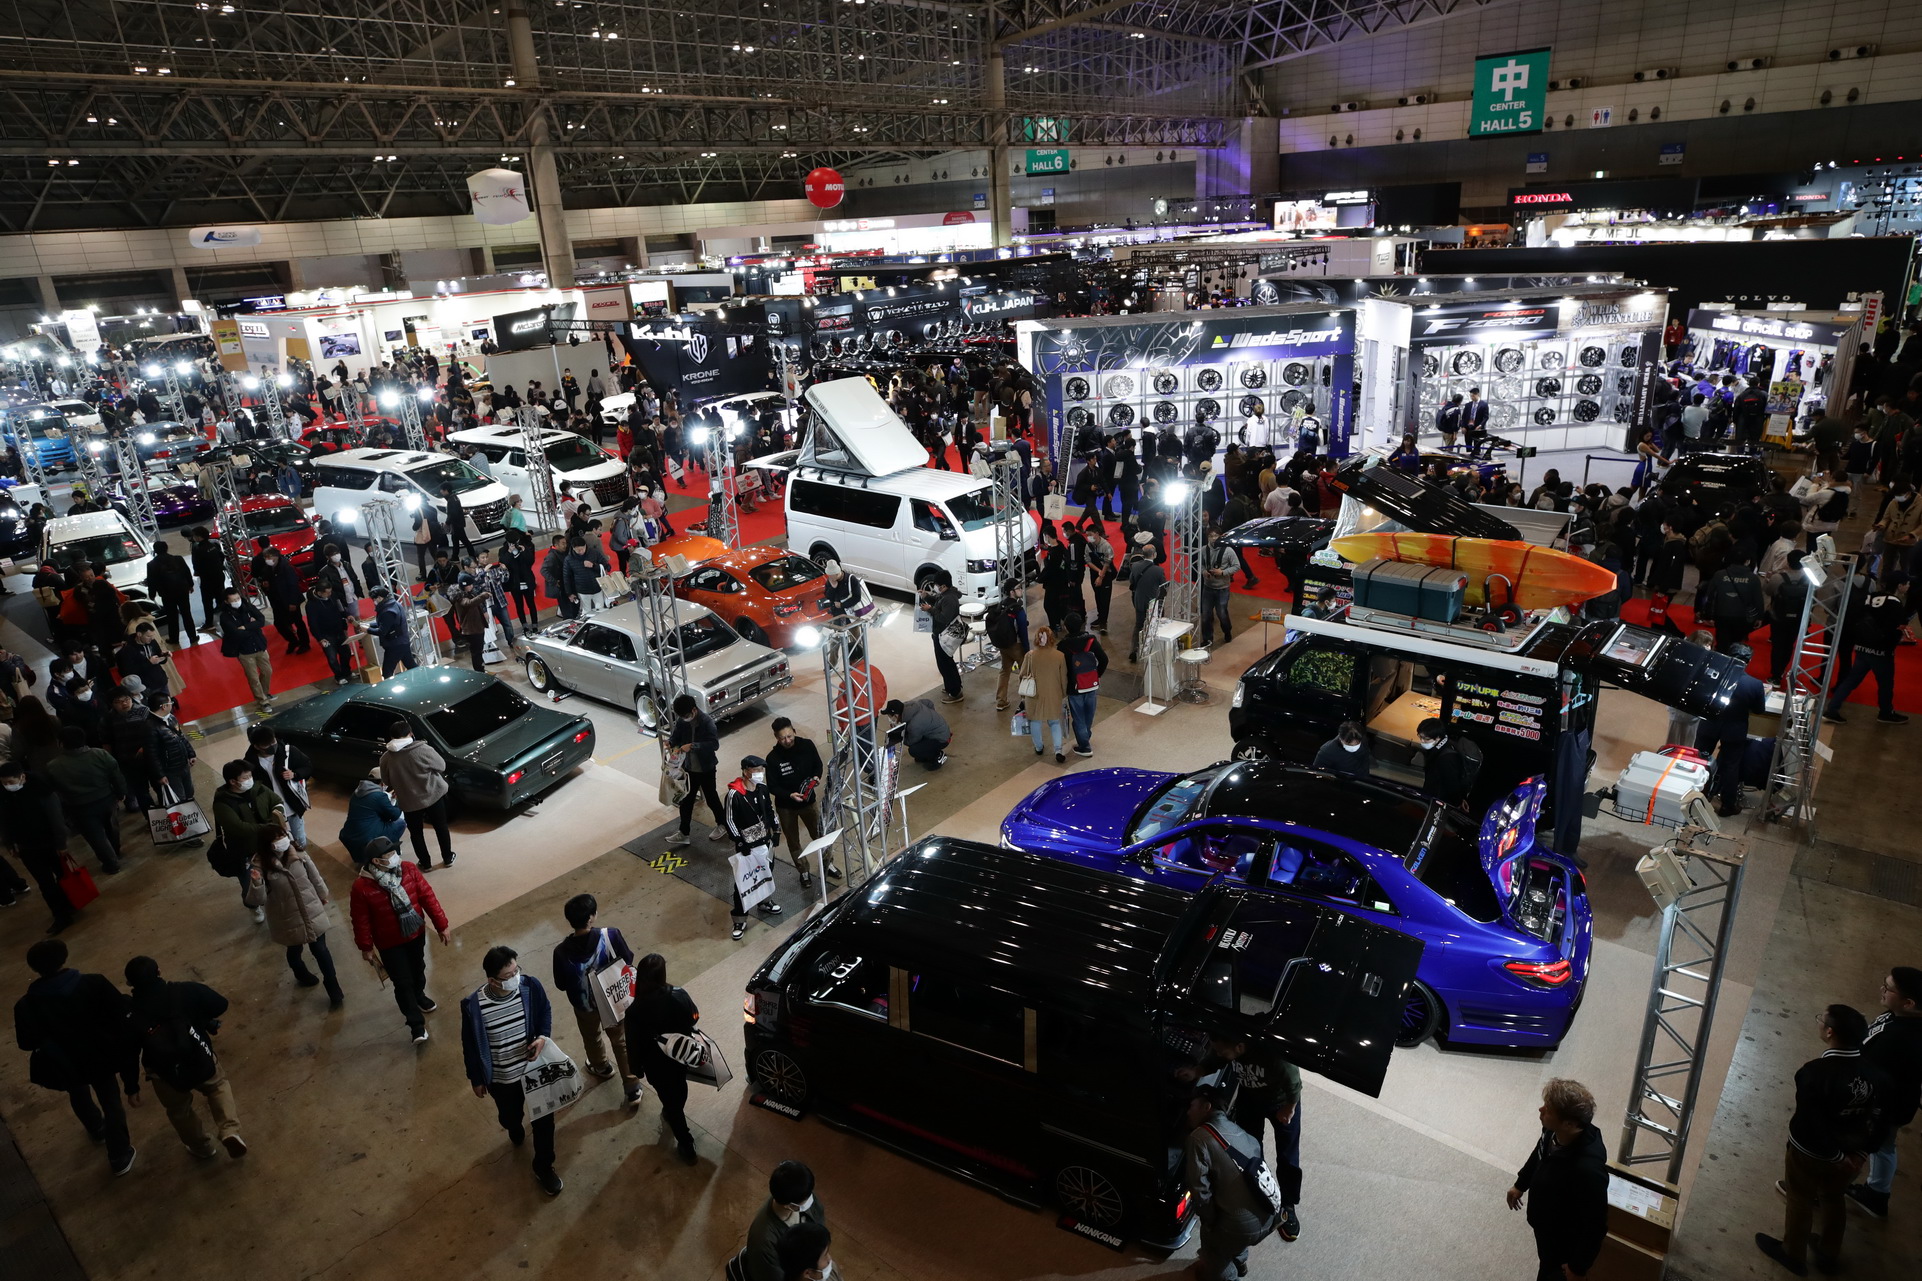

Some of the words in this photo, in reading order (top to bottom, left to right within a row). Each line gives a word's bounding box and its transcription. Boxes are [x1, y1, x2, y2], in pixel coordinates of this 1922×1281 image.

[1491, 59, 1530, 101] 中
[1490, 100, 1526, 112] CENTER
[1480, 119, 1517, 132] HALL
[1518, 111, 1532, 128] 5
[1032, 161, 1054, 171] HALL
[1054, 156, 1063, 169] 6
[1514, 193, 1573, 204] HONDA
[972, 302, 1000, 315] KUHL
[1002, 296, 1034, 311] JAPAN
[1483, 309, 1546, 318] FORGED
[1589, 303, 1620, 315] WEDS
[1462, 315, 1544, 327] ZERO
[1588, 310, 1653, 326] ADVENTURE
[1231, 327, 1342, 348] WedsSport
[1742, 321, 1783, 336] OFFICIAL
[1785, 326, 1813, 339] SHOP
[682, 369, 720, 381] KRONE
[1637, 387, 1648, 426] ADVENTURE
[606, 973, 630, 998] SPHERE
[763, 1098, 801, 1117] NANKANG
[1075, 1222, 1123, 1247] NANKANG
